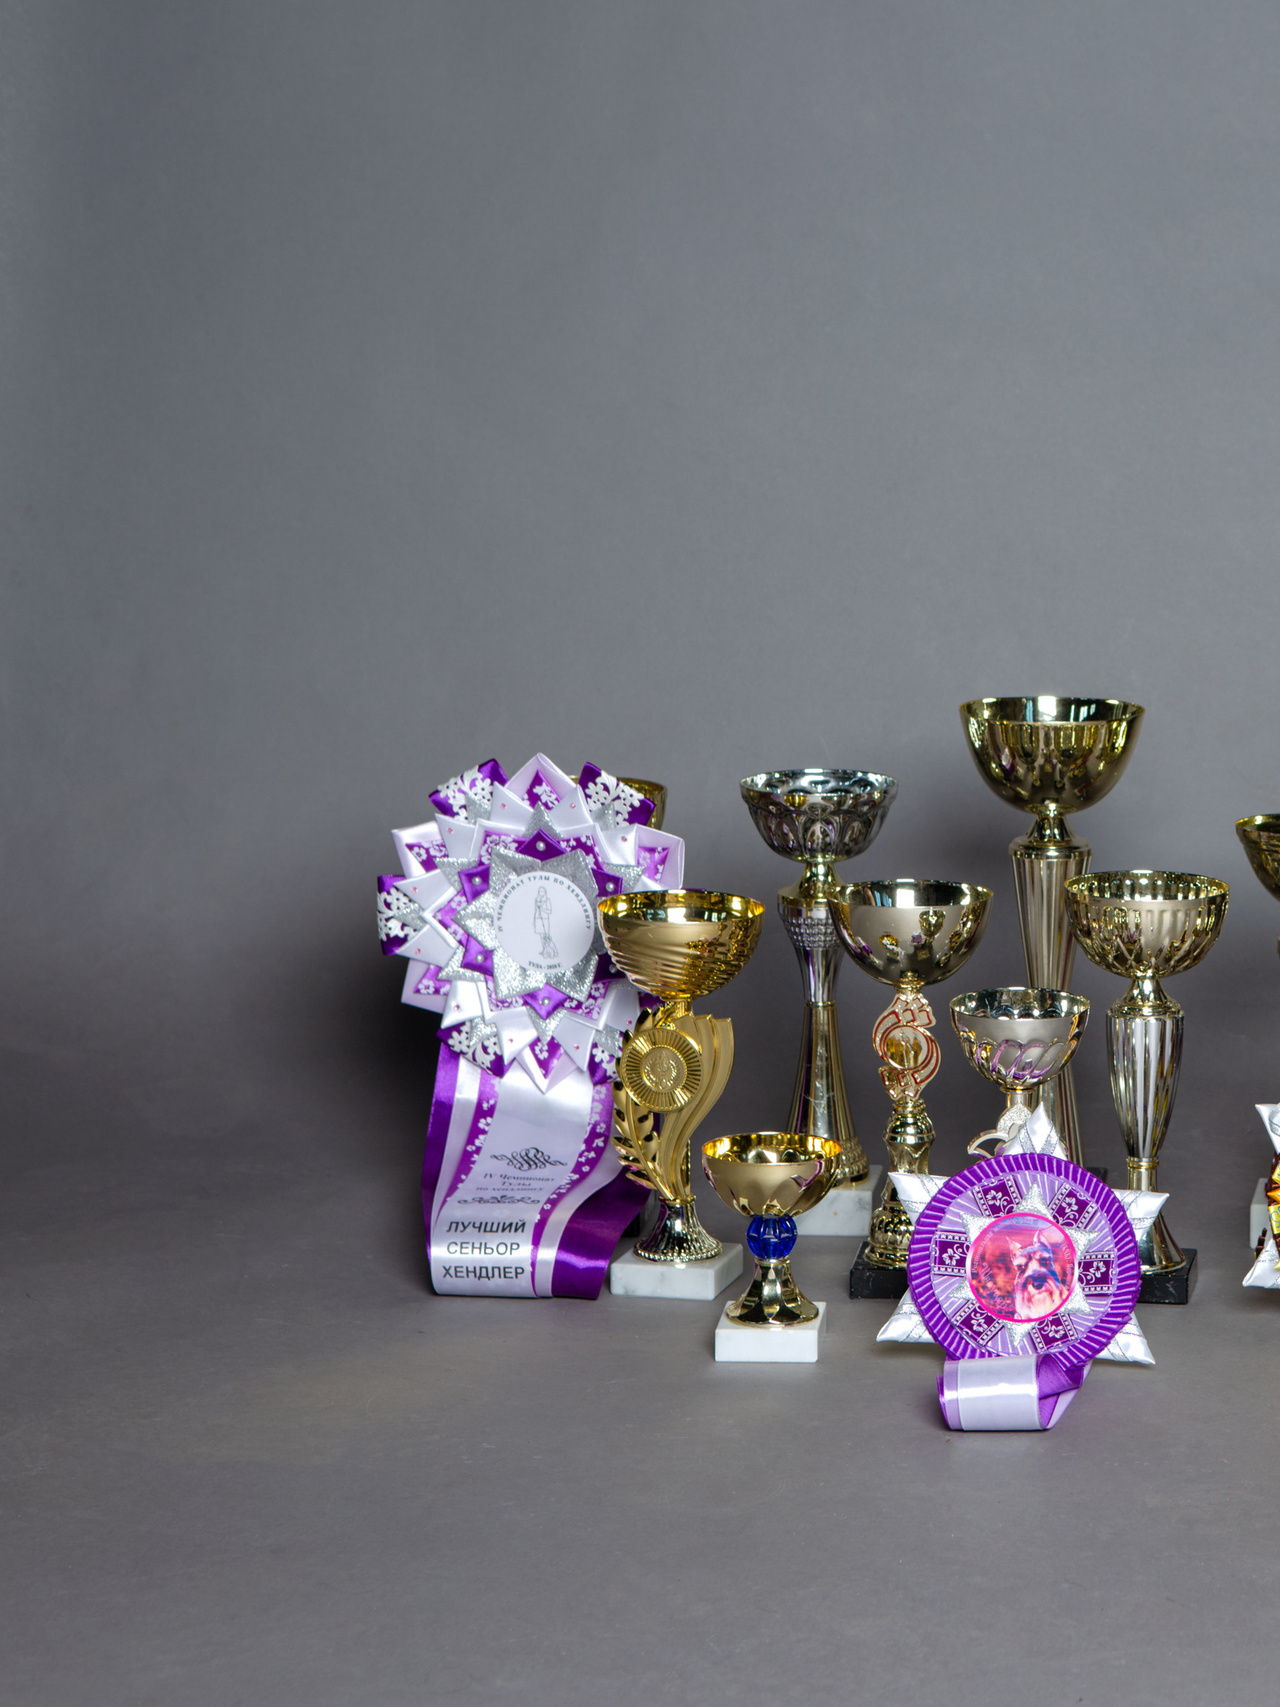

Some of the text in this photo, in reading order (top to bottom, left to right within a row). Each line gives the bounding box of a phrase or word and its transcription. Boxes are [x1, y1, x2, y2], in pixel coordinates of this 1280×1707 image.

[496, 879, 525, 922] ЧЕМПИОНАТ
[553, 877, 565, 886] ПО
[566, 884, 591, 930] ХЕНДЛИНГУ
[499, 1173, 555, 1182] Чемпионат
[446, 1219, 527, 1234] ЛУЧШИЙ
[446, 1241, 521, 1256] СЕНЬОР
[442, 1264, 526, 1281] ХЕНДЛЕР
